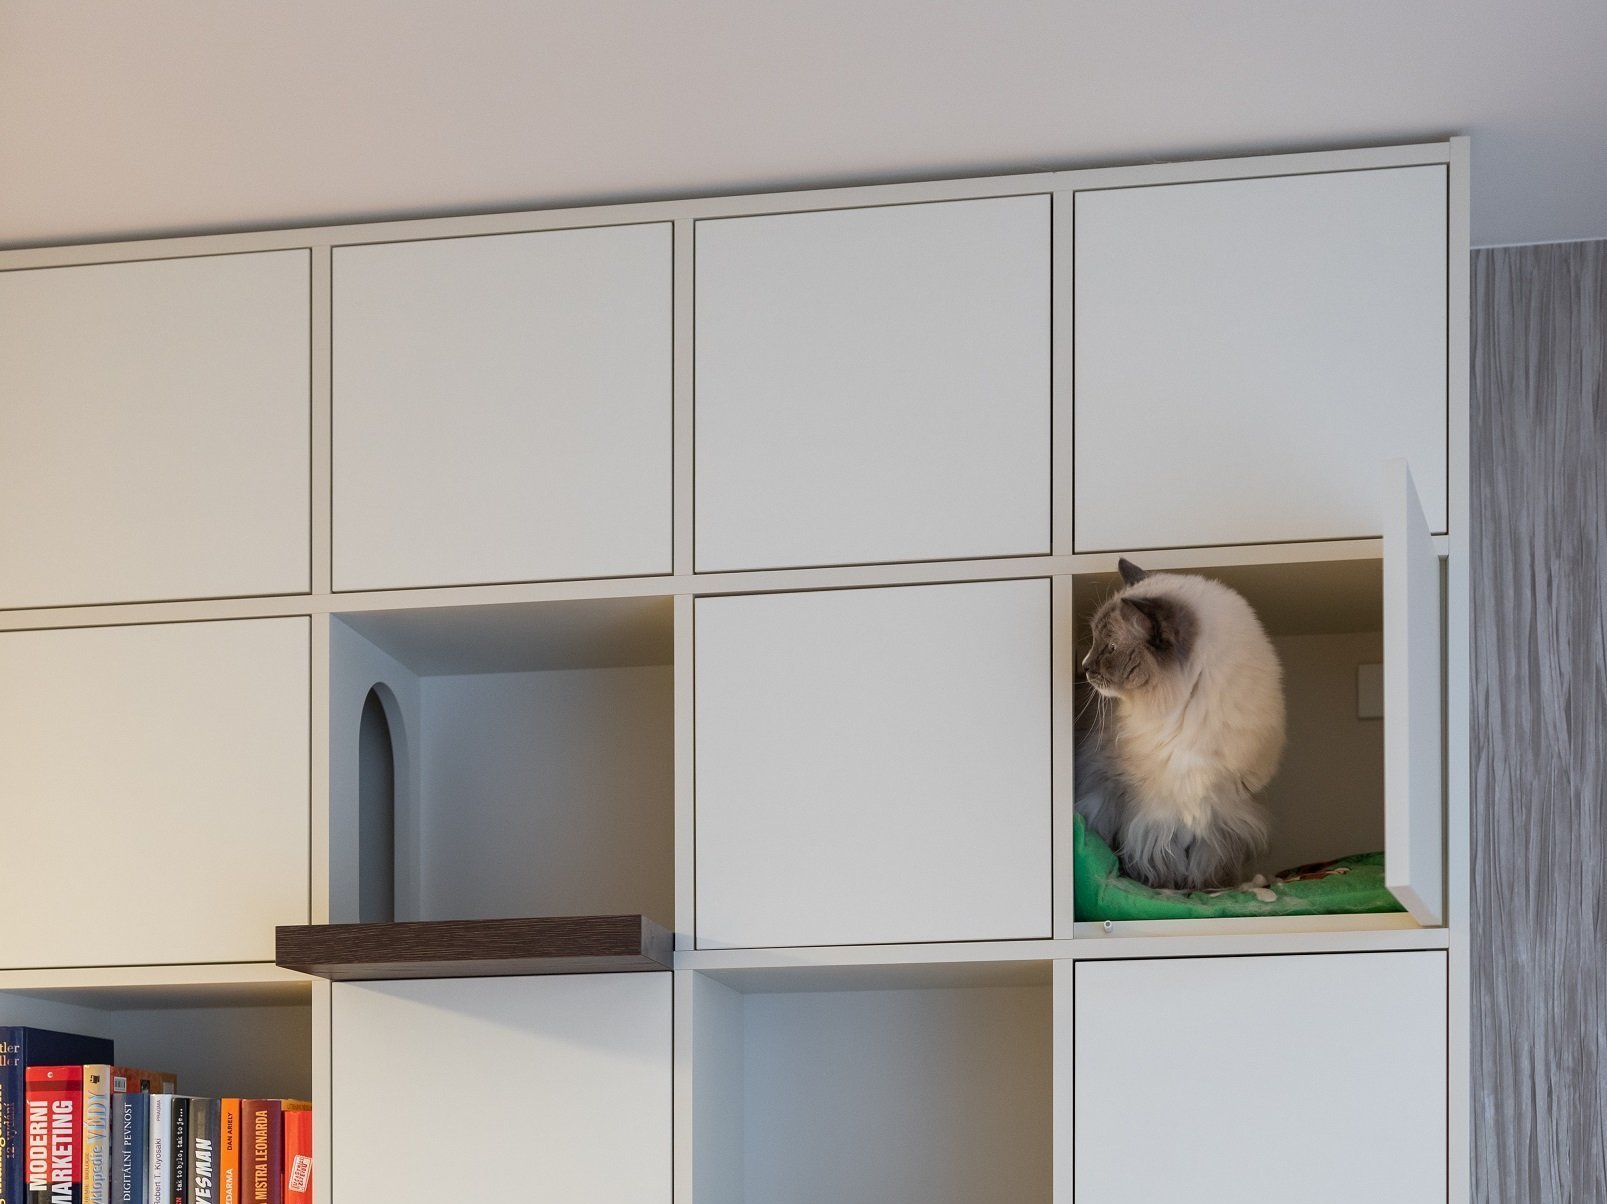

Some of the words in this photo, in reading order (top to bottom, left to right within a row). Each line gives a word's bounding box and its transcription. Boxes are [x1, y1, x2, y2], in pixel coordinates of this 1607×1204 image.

[83, 1090, 107, 1144] VĚDY
[123, 1102, 132, 1146] PEVNOST
[255, 1110, 268, 1161] LEONARDA
[27, 1100, 48, 1191] MODERNÍ
[154, 1138, 163, 1171] Kiyosaki
[121, 1151, 132, 1201] DIGITÁLNÍ
[154, 1172, 161, 1180] T.
[255, 1163, 268, 1200] MISTRA
